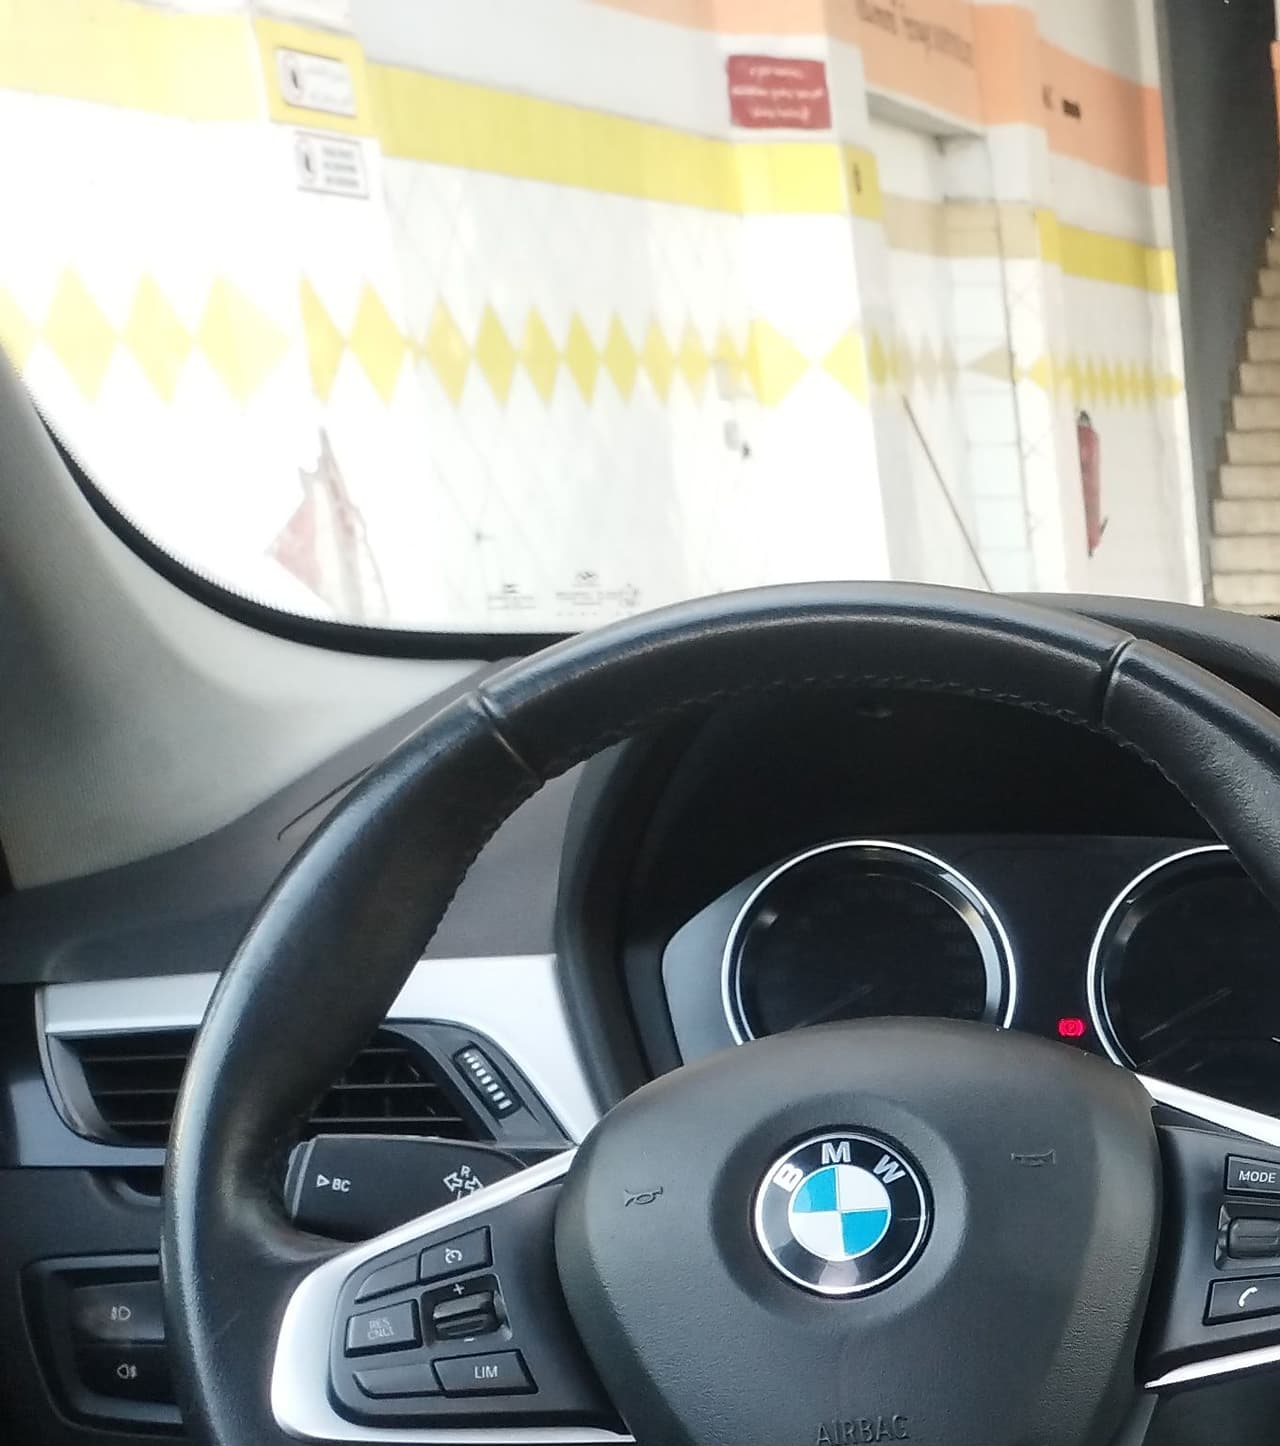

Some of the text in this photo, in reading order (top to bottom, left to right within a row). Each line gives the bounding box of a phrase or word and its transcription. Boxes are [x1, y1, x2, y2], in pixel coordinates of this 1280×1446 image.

[772, 1140, 906, 1193] BMW
[1238, 1170, 1277, 1184] MODE
[332, 1178, 351, 1193] BC
[474, 1365, 498, 1379] LIM
